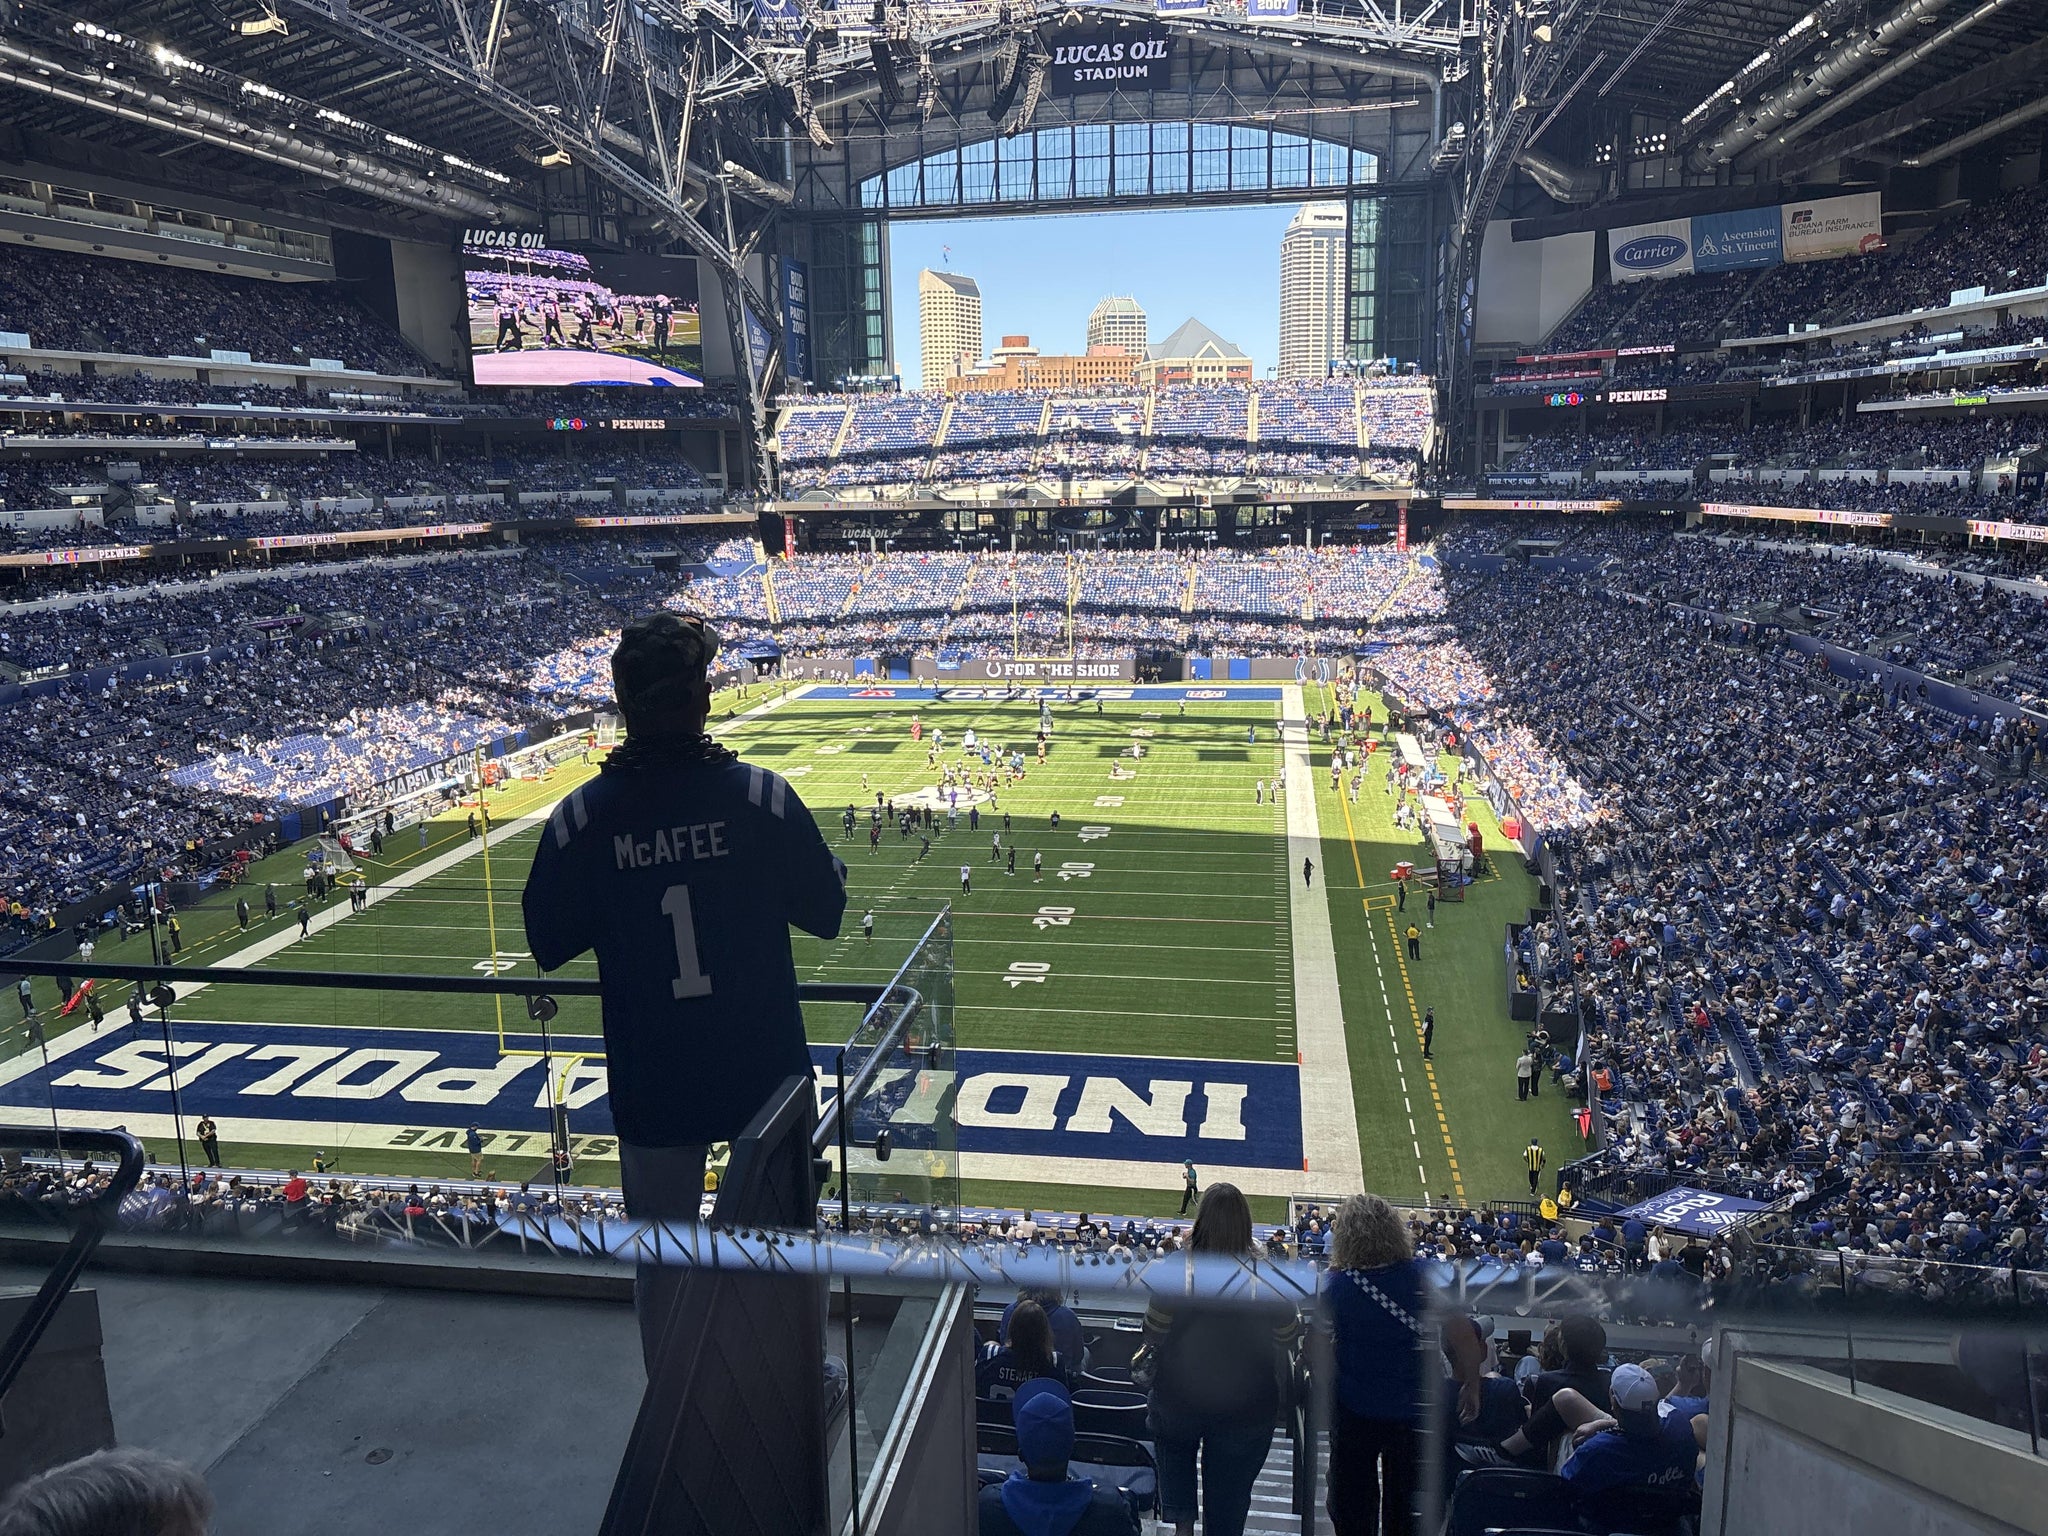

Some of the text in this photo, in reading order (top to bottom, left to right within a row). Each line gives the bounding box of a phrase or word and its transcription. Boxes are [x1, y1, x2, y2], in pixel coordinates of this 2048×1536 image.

[1257, 0, 1289, 10] 2007
[1054, 40, 1168, 65] LUCAS OIL
[1074, 65, 1148, 82] STADIUM
[1789, 218, 1849, 231] INDIANA FARM
[1789, 221, 1875, 238] BUREAU INSURANCE
[463, 228, 546, 249] LUCAS OIL
[1721, 227, 1776, 242] Ascension
[1624, 243, 1677, 263] Carrier
[788, 284, 806, 304] LIGHT
[1608, 389, 1667, 403] PEEWEES
[611, 419, 665, 430] PEEWEES
[1313, 492, 1354, 500] PEEWEES
[981, 500, 991, 508] 13
[1556, 502, 1595, 510] PEEWEES
[644, 516, 682, 524] PEEWEES
[302, 534, 337, 545] PEEWEES
[842, 528, 872, 539] LUCAS
[874, 528, 889, 538] OIL
[2011, 526, 2045, 540] PEEWEES
[99, 547, 141, 560] PEEWEES
[1004, 663, 1120, 677] FOR THE SHOE
[613, 820, 731, 870] McAFEE
[661, 884, 713, 1001] 1
